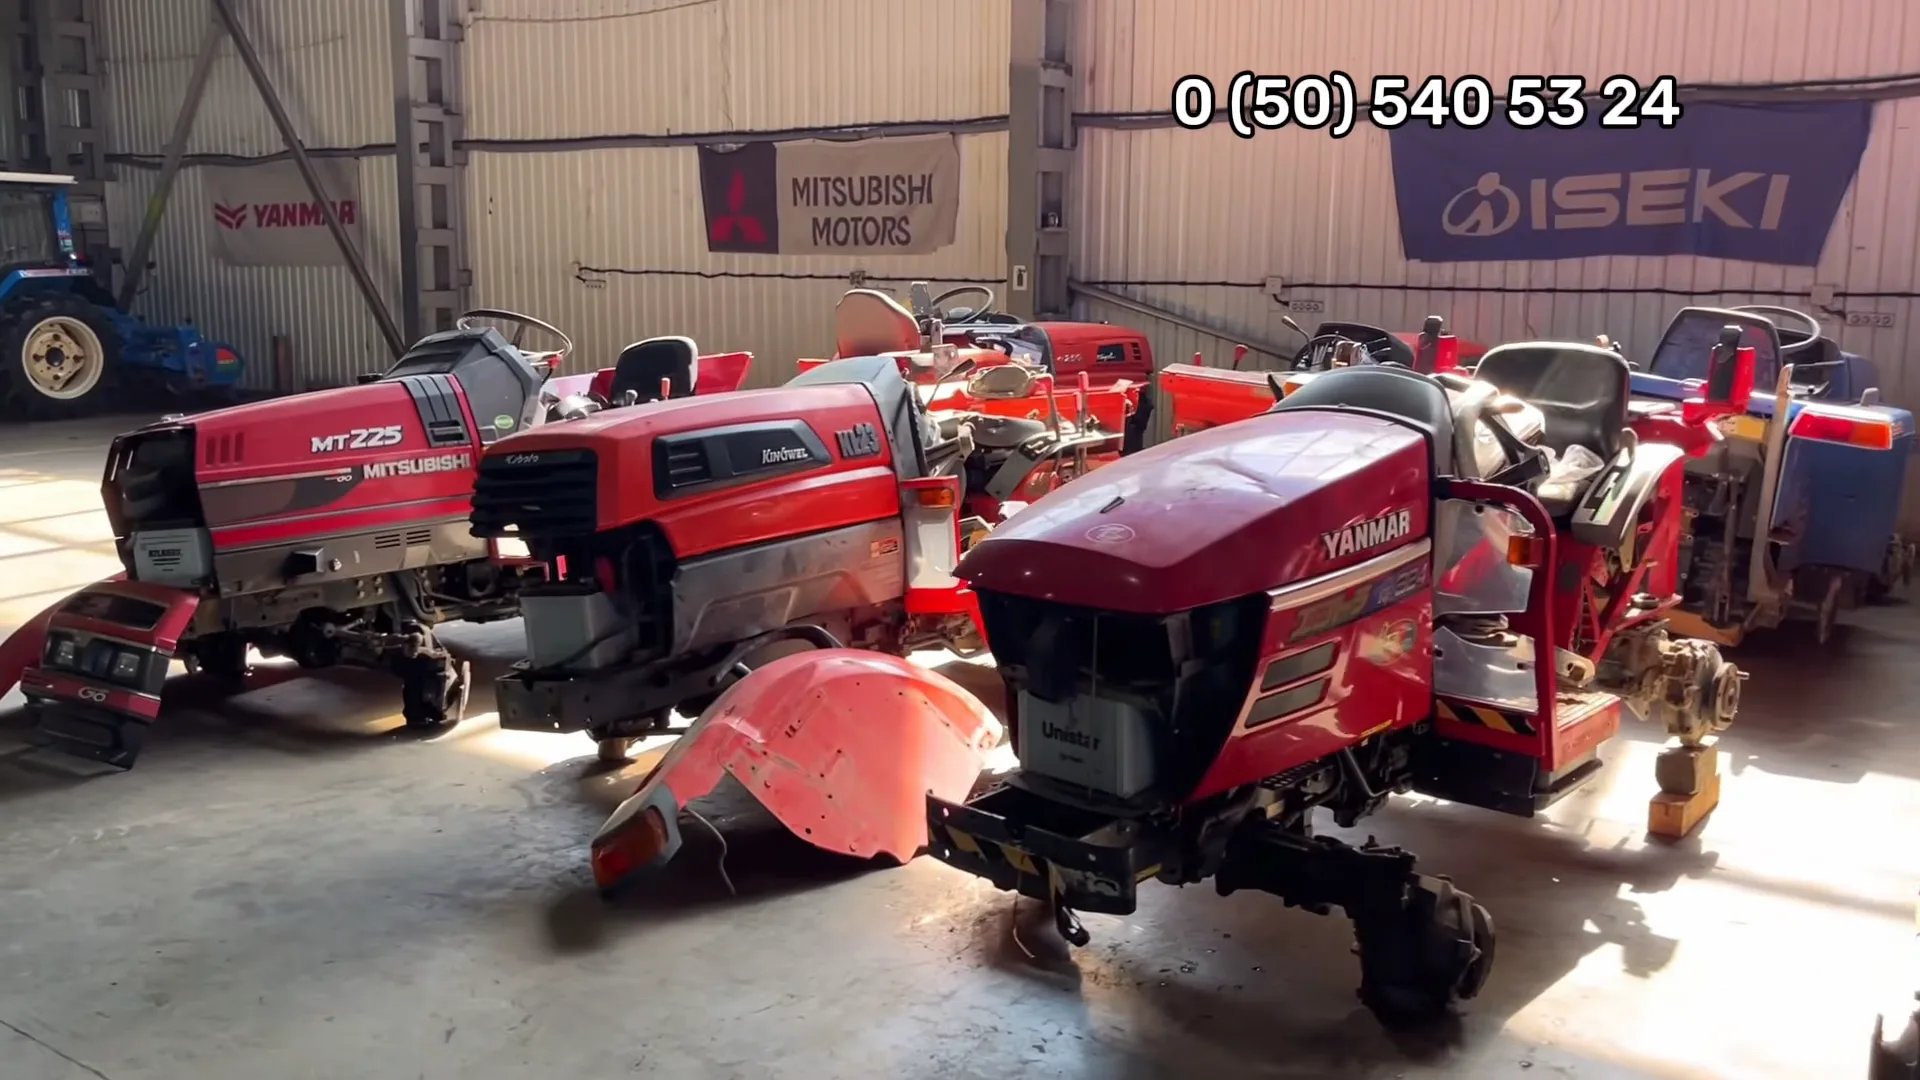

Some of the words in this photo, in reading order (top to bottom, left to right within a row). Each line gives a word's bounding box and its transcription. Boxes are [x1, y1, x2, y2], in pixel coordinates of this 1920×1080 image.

[792, 174, 933, 207] MITSUBISHI
[1530, 168, 1790, 230] ISEKI
[812, 216, 911, 246] MOTORS
[311, 425, 402, 452] MT225
[363, 453, 471, 480] MITSUBISHI
[1323, 510, 1410, 560] YANMAR
